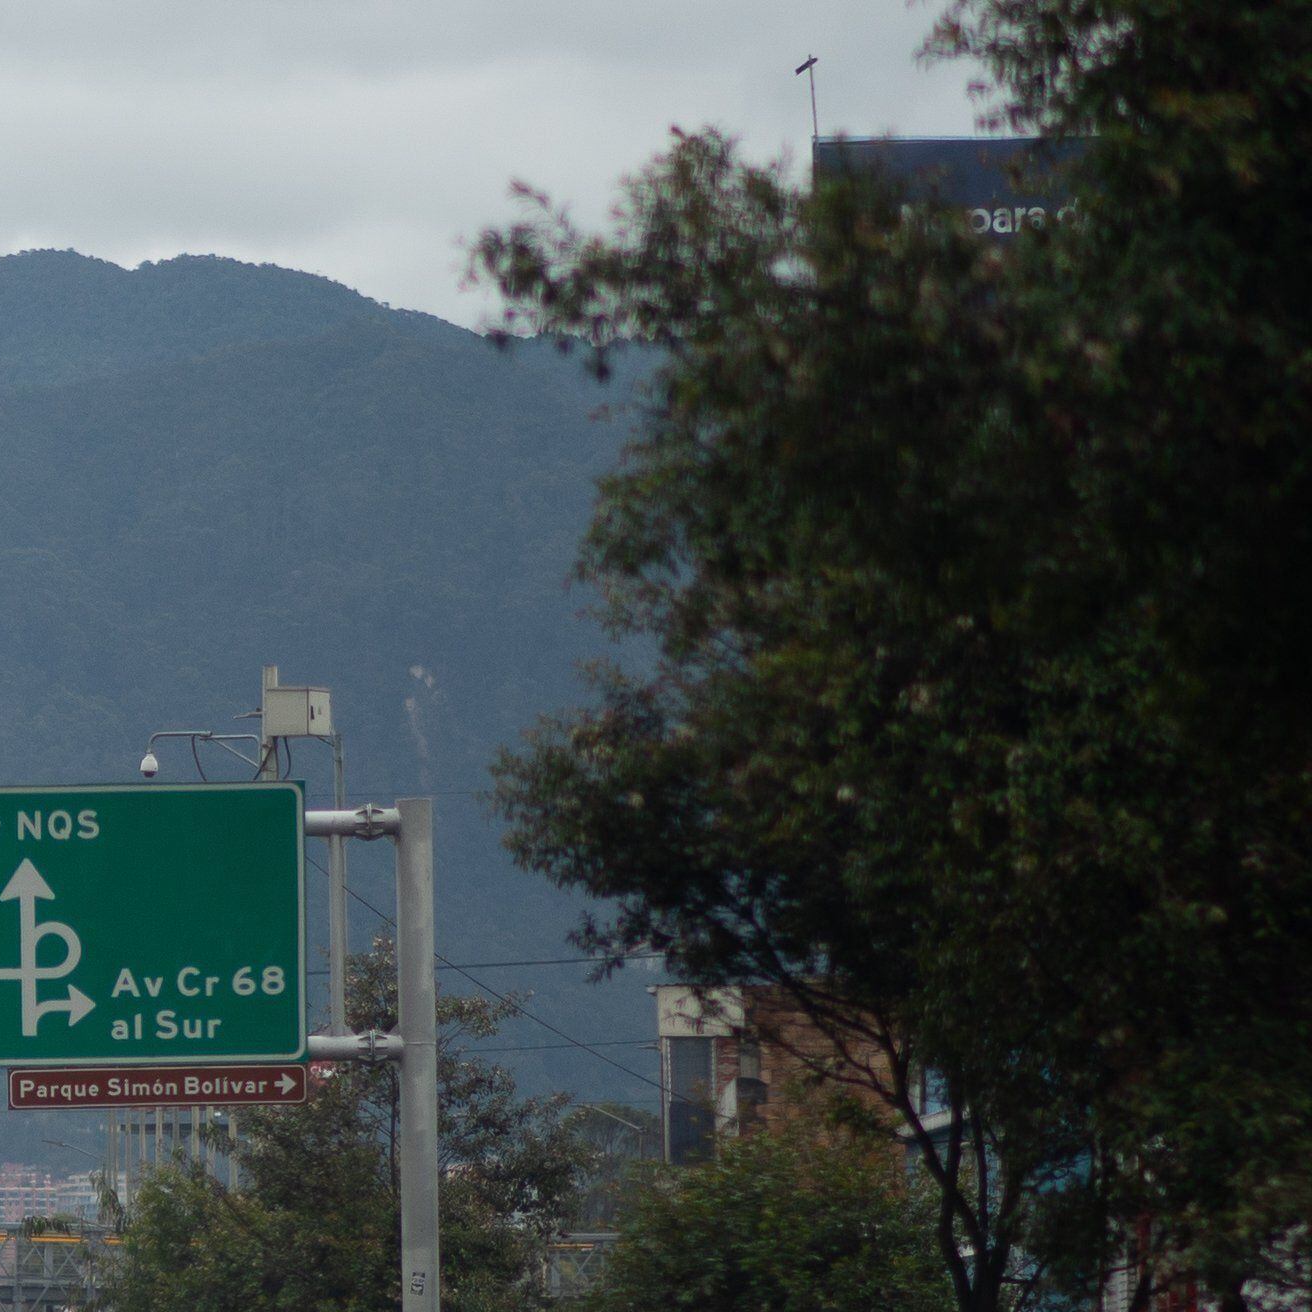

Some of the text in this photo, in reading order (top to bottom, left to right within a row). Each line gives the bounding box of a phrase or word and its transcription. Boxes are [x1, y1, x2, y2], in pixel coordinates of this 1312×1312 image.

[17, 810, 101, 841] NQS
[111, 965, 286, 998] Av Cr 68
[111, 1009, 223, 1040] al Sur
[19, 1076, 268, 1101] Parque Simón Bolívar
